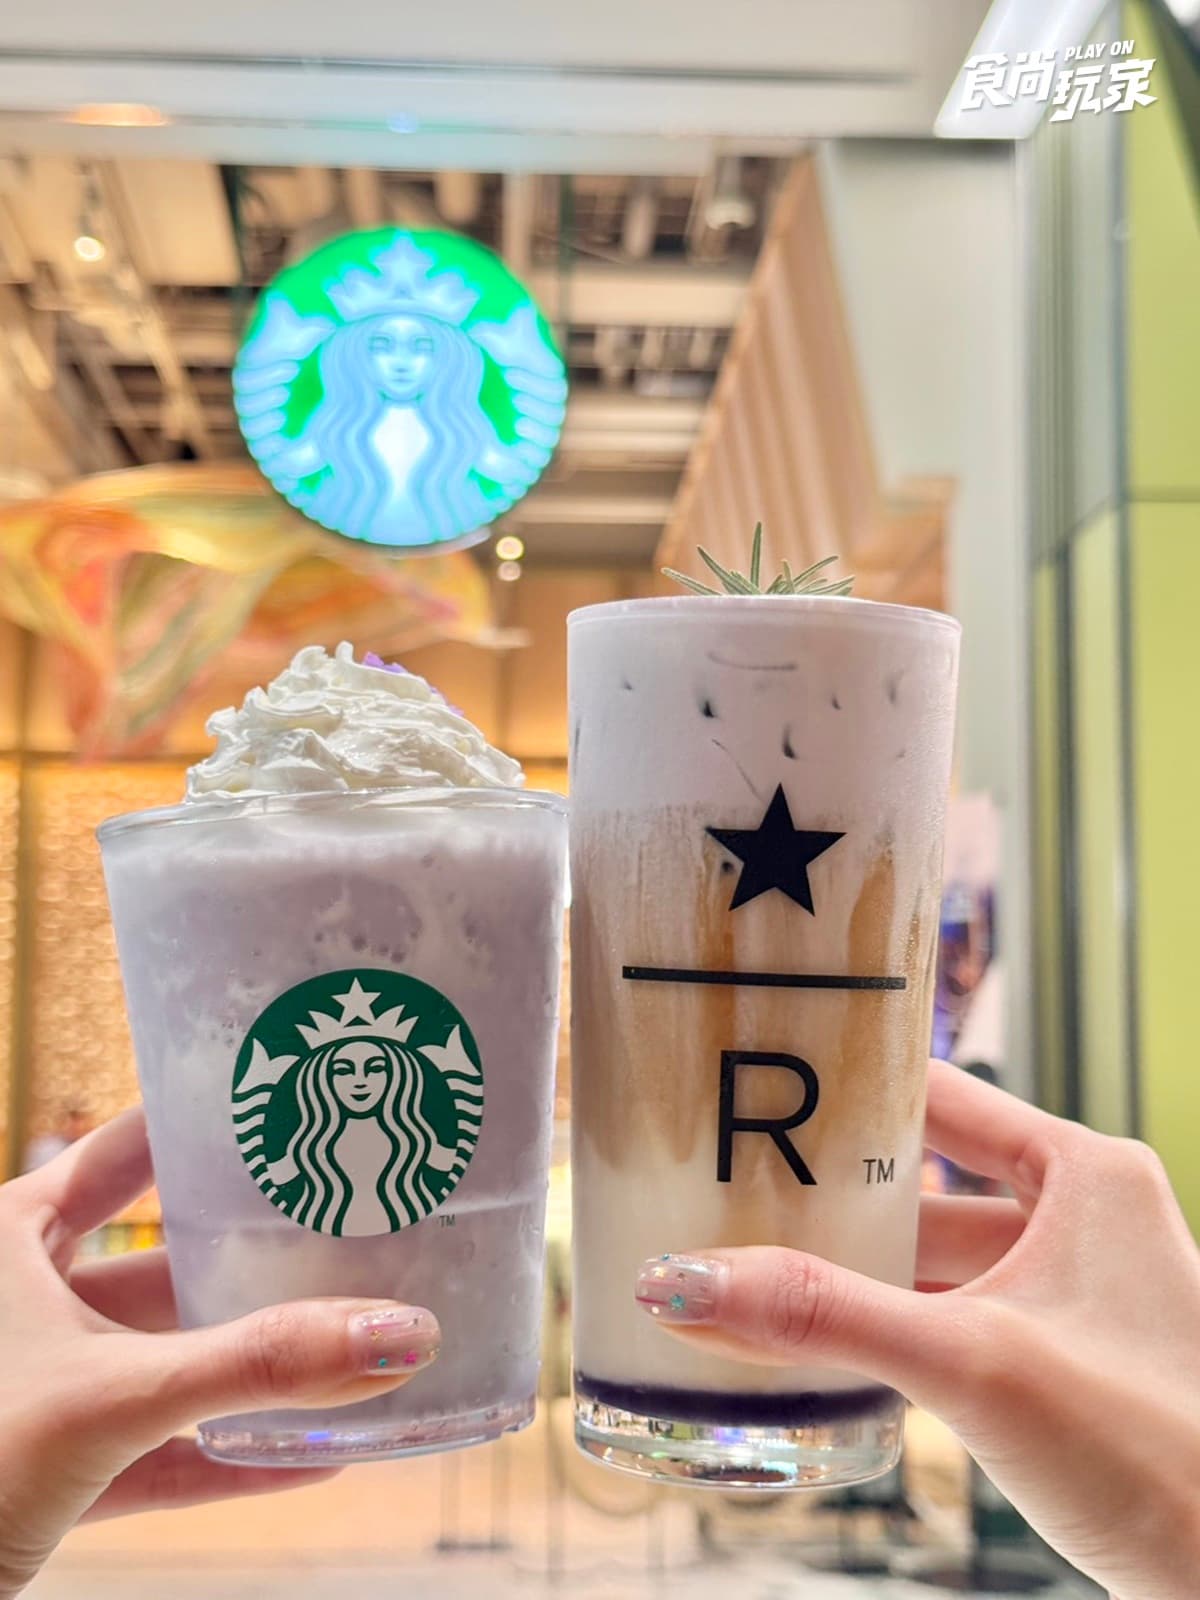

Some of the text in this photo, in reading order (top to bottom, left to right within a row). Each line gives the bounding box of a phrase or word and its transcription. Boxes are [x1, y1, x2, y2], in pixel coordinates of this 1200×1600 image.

[716, 1050, 820, 1186] R
[862, 1157, 895, 1185] TM
[439, 1213, 456, 1228] TM
